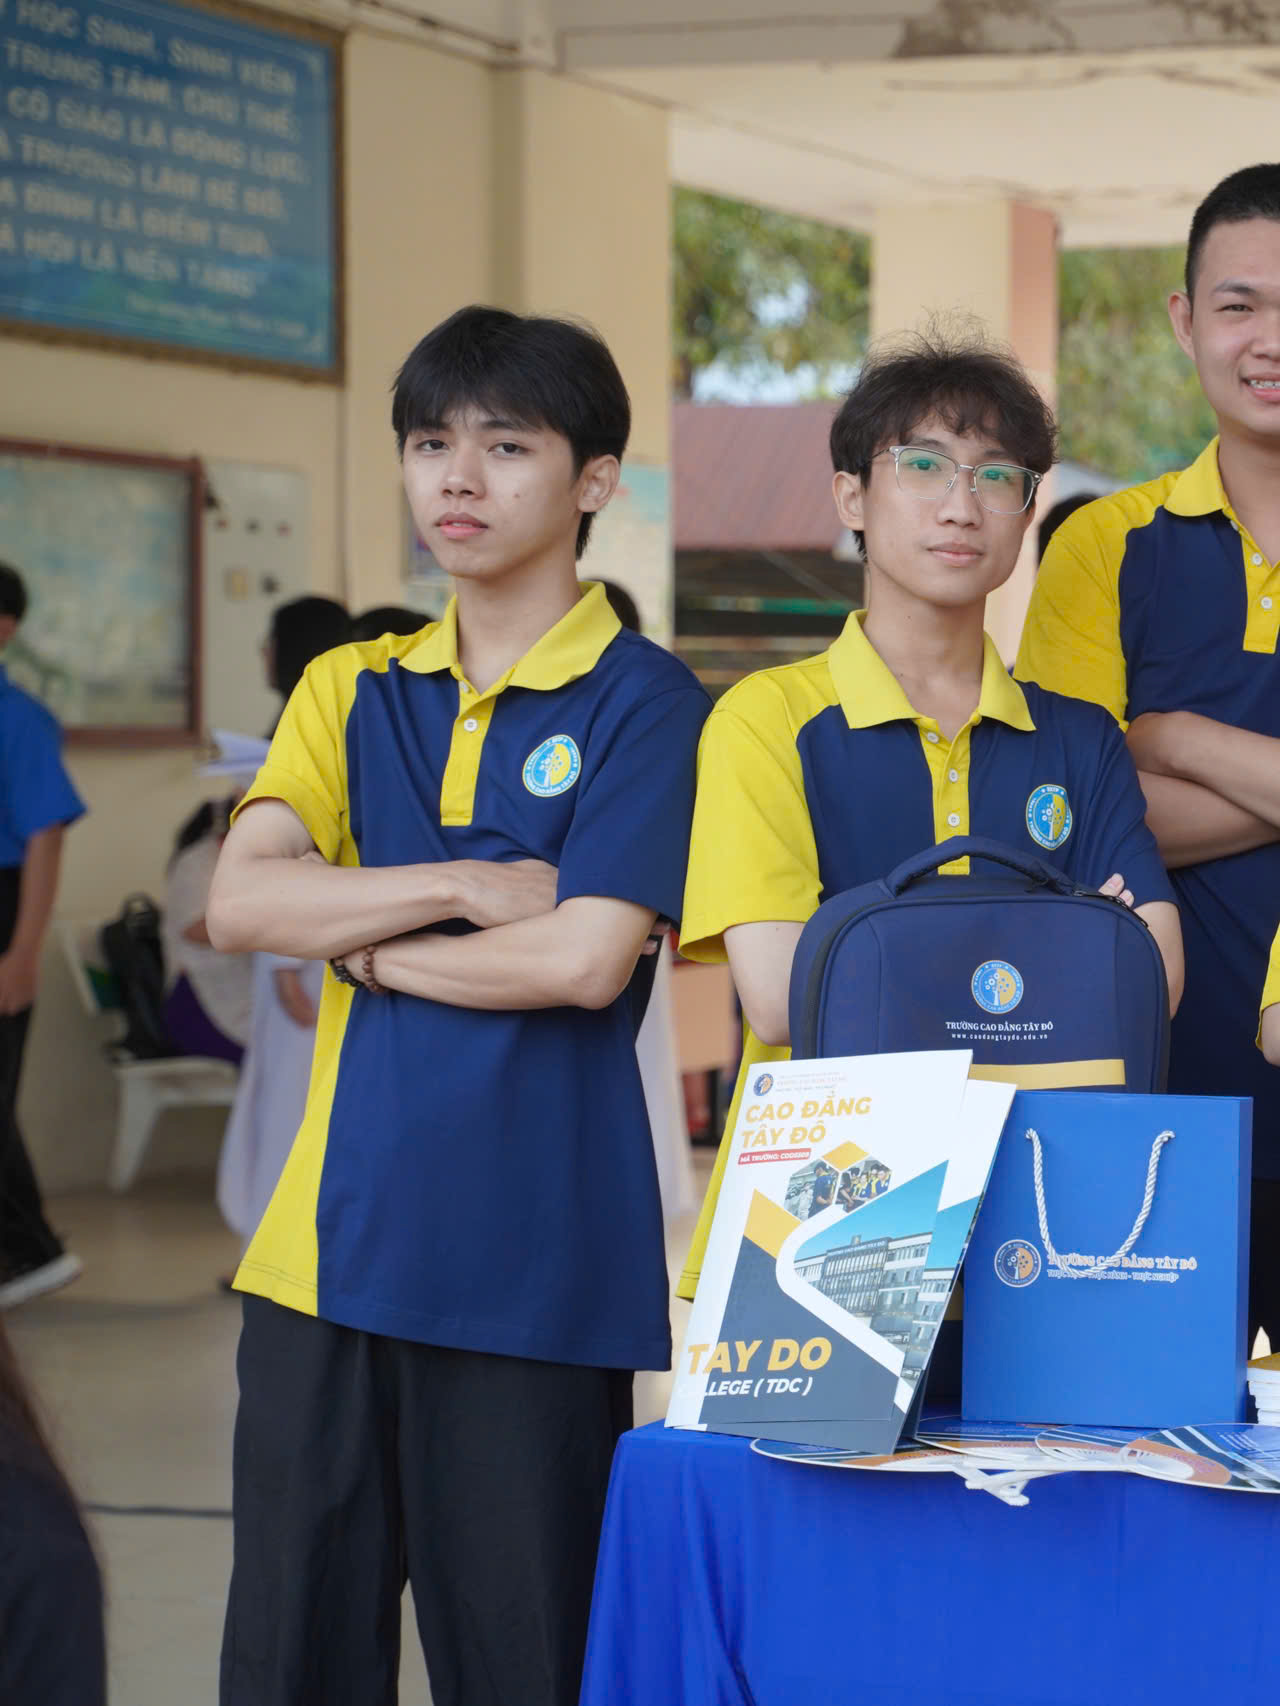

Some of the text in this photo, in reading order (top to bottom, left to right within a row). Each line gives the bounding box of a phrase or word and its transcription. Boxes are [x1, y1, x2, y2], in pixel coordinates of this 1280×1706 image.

[980, 1023, 997, 1032] CAO
[745, 1089, 873, 1124] CAO ĐẲNG
[741, 1120, 827, 1149] TÂY ĐÔ
[687, 1336, 832, 1375] TAY DO
[766, 1378, 803, 1394] TDC
